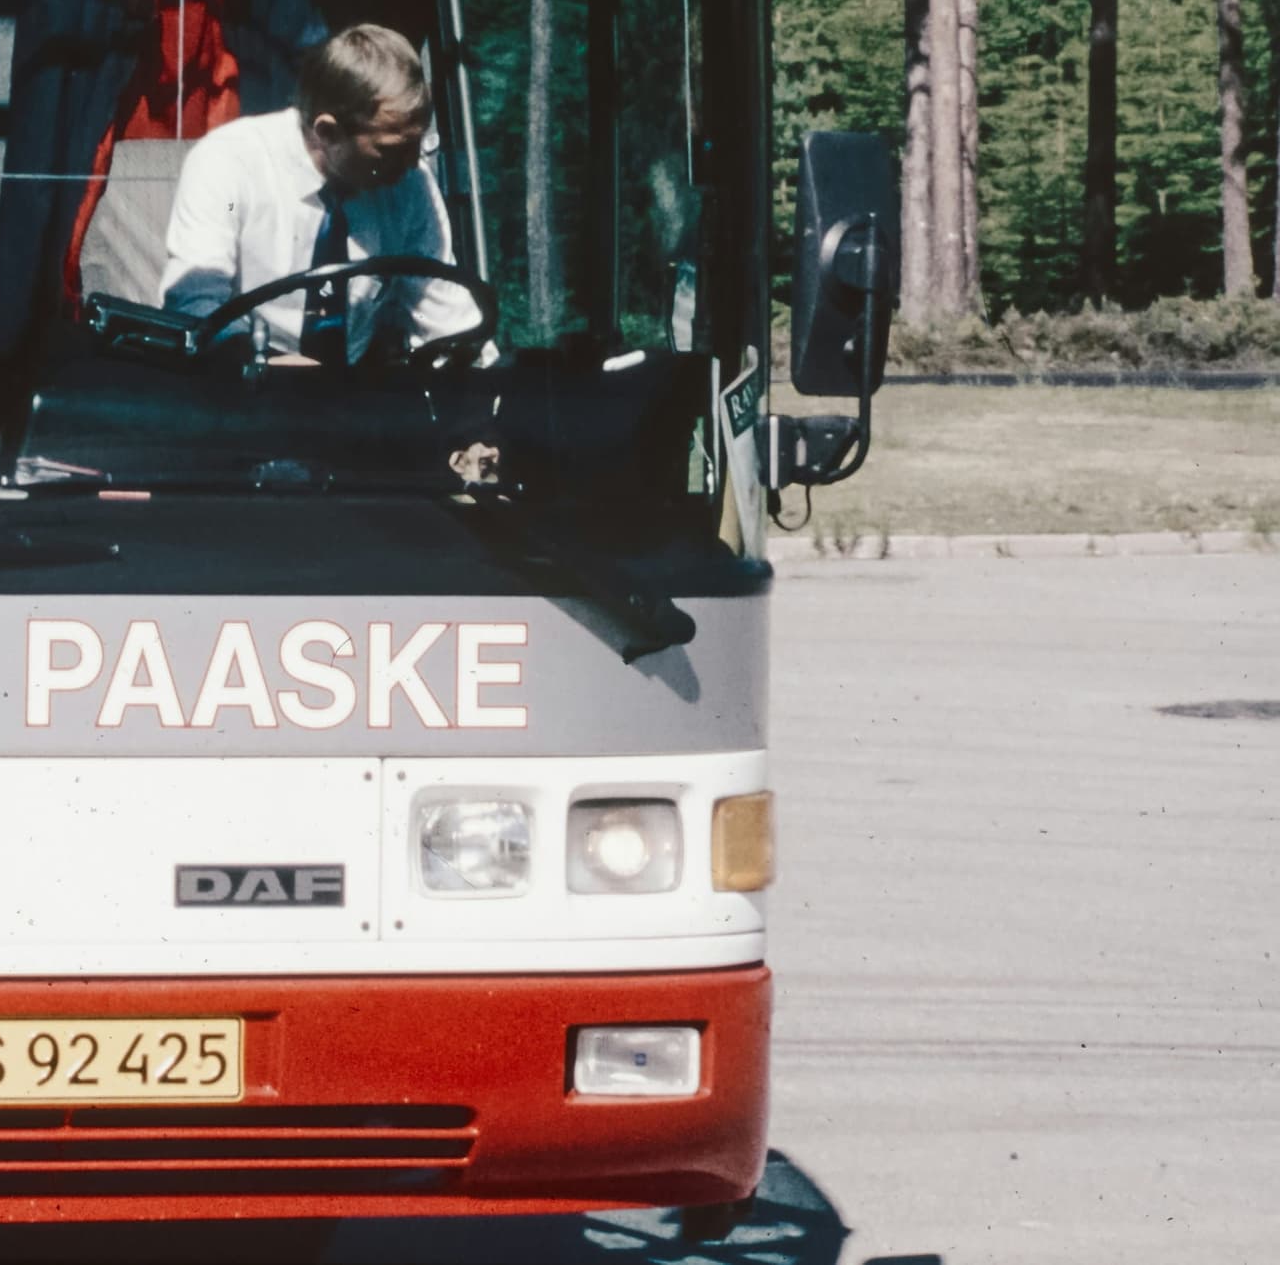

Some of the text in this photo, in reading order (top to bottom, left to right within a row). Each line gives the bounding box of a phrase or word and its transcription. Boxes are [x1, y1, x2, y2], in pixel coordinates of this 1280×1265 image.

[25, 618, 528, 729] PAASKE
[178, 869, 342, 902] DAF
[27, 1033, 100, 1086] 92
[117, 1033, 228, 1086] 425
